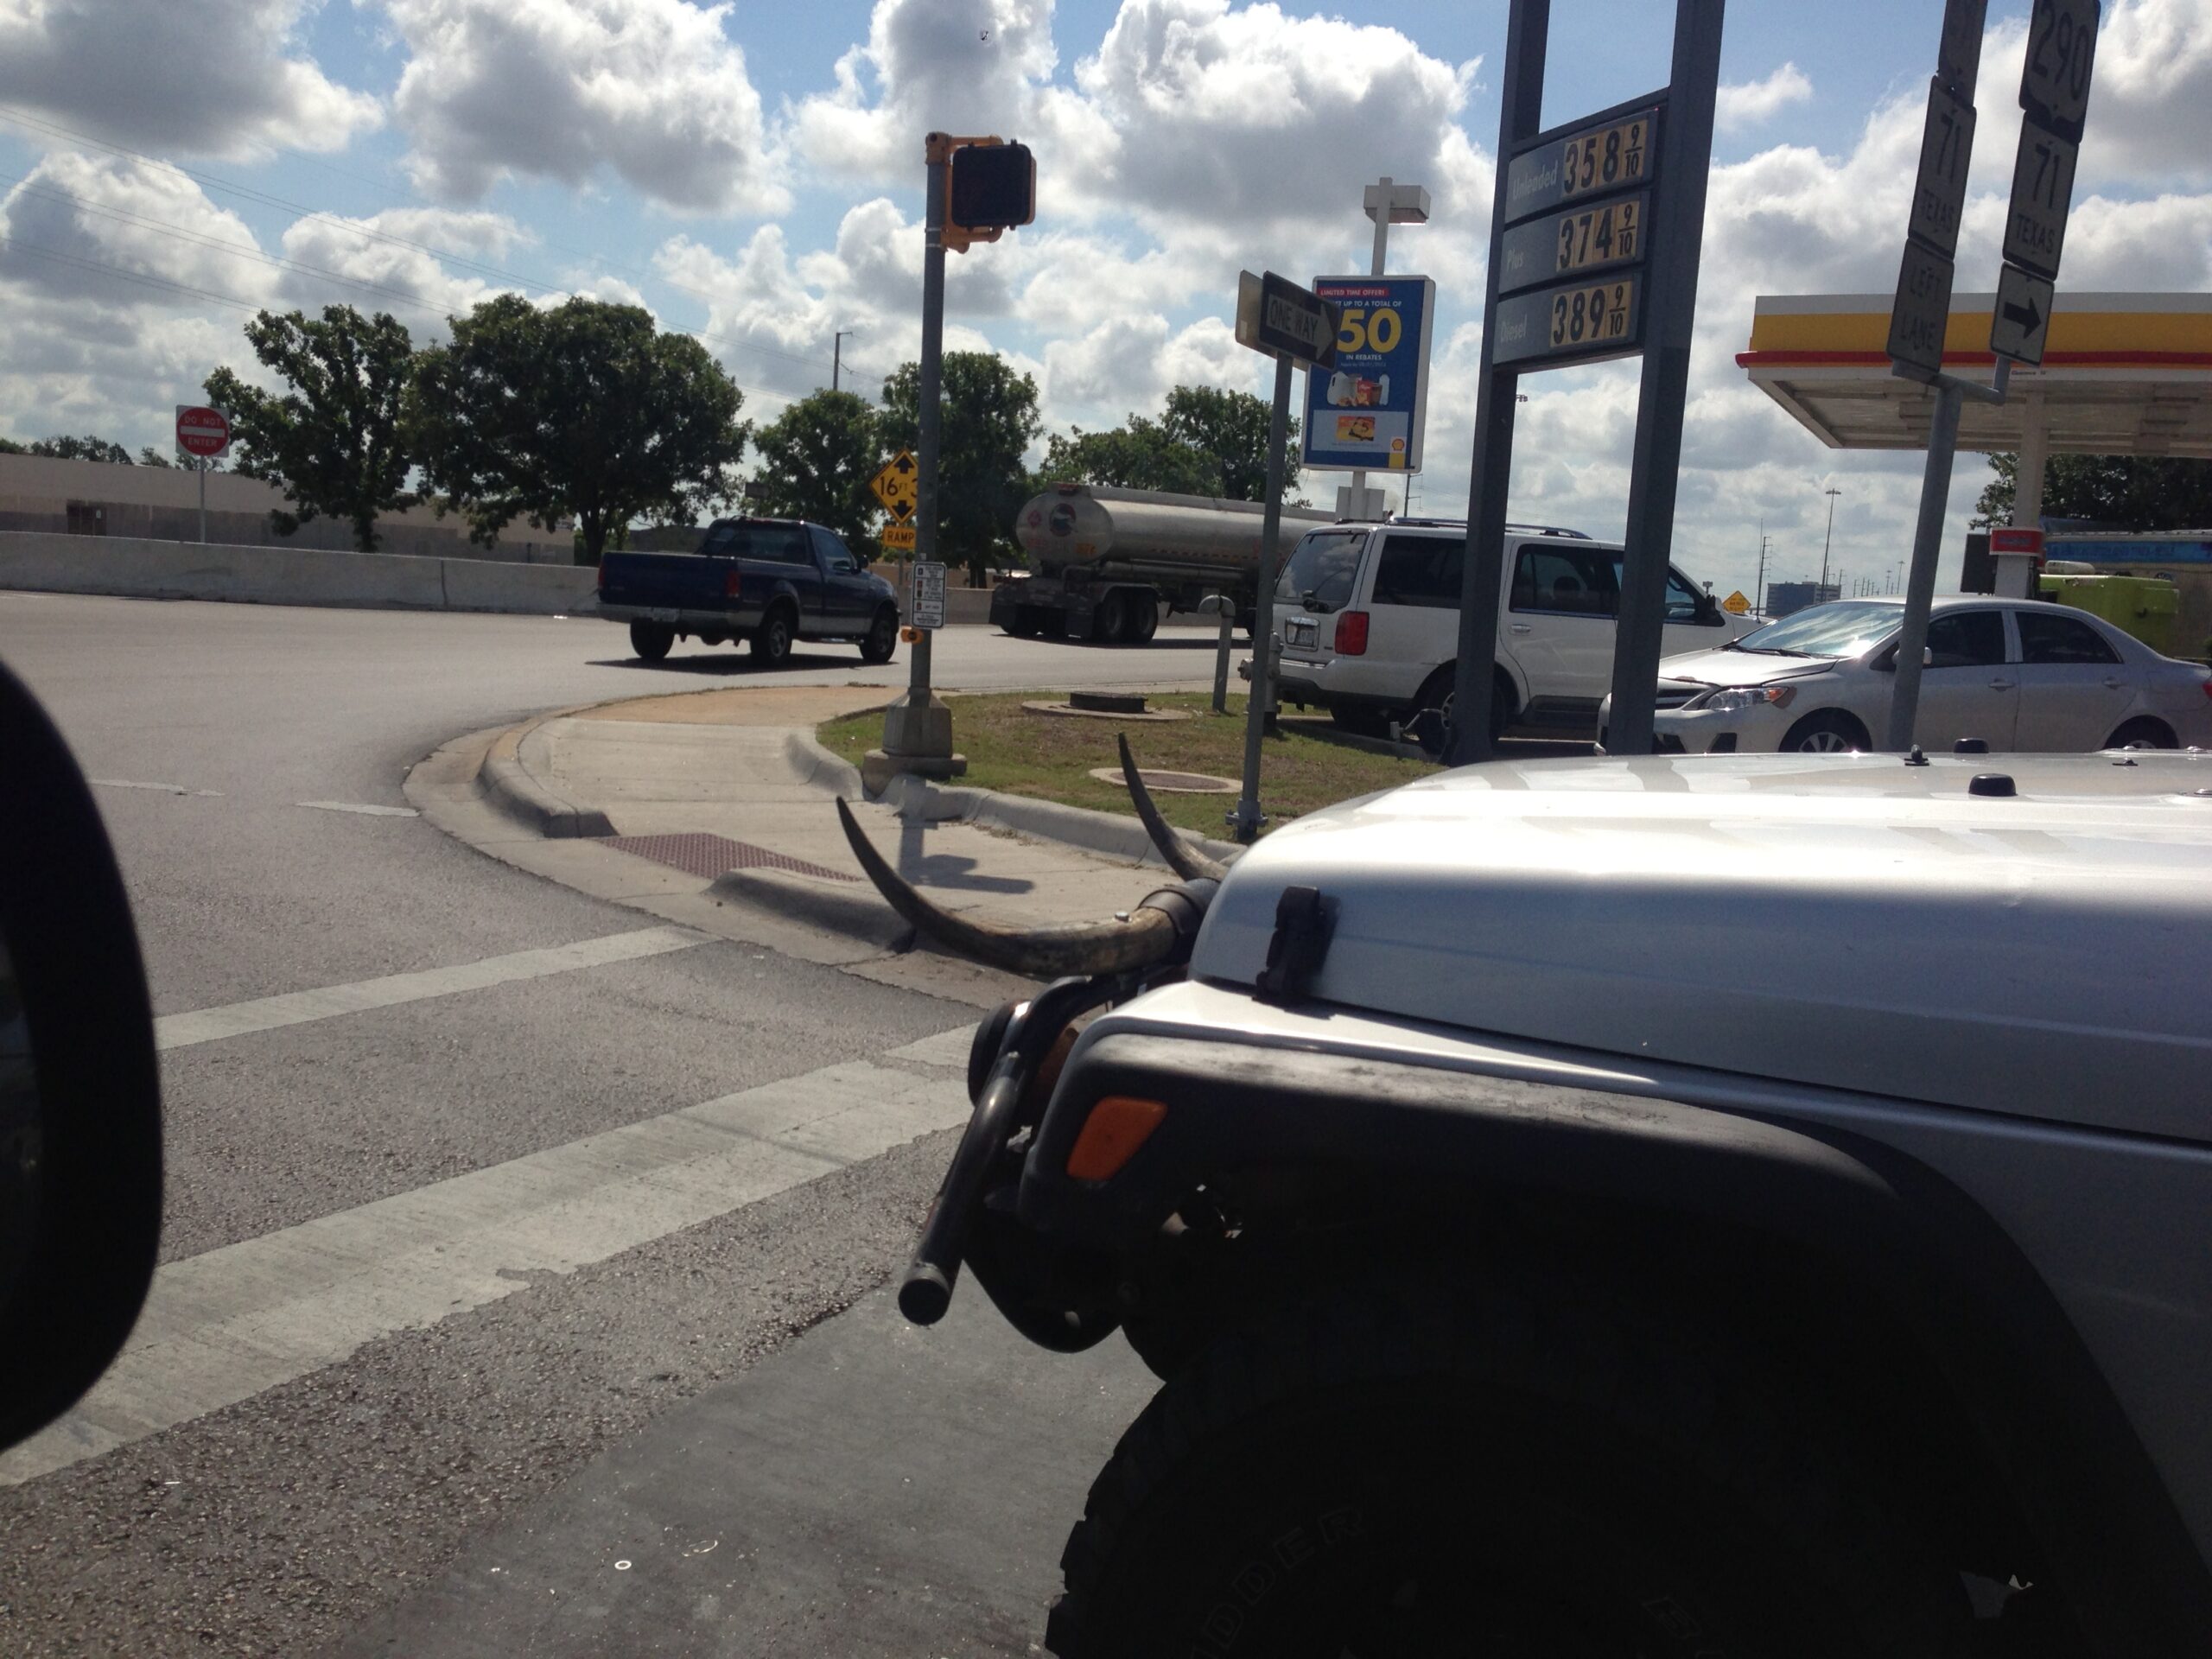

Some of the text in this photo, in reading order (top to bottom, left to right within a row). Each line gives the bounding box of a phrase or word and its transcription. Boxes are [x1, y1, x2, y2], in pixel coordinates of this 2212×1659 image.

[2032, 3, 2089, 101] 290
[1512, 161, 1558, 199] Unleaded
[1563, 130, 1620, 194] 358
[1936, 112, 1961, 183] 71
[2032, 143, 2060, 209] 71
[1919, 188, 1955, 233] TEXAS
[1506, 248, 1524, 272] Plus
[1559, 208, 1613, 269] 374
[2017, 213, 2056, 254] TEXAS
[1910, 263, 1942, 302] LEFT
[1270, 299, 1319, 342] ONE WAY
[1500, 314, 1528, 343] Diesel
[1553, 289, 1605, 344] 389
[1901, 312, 1937, 351] LANE
[184, 416, 221, 426] DO NOT
[188, 436, 218, 448] ENTER
[880, 476, 899, 497] 16
[887, 530, 915, 544] RAMP
